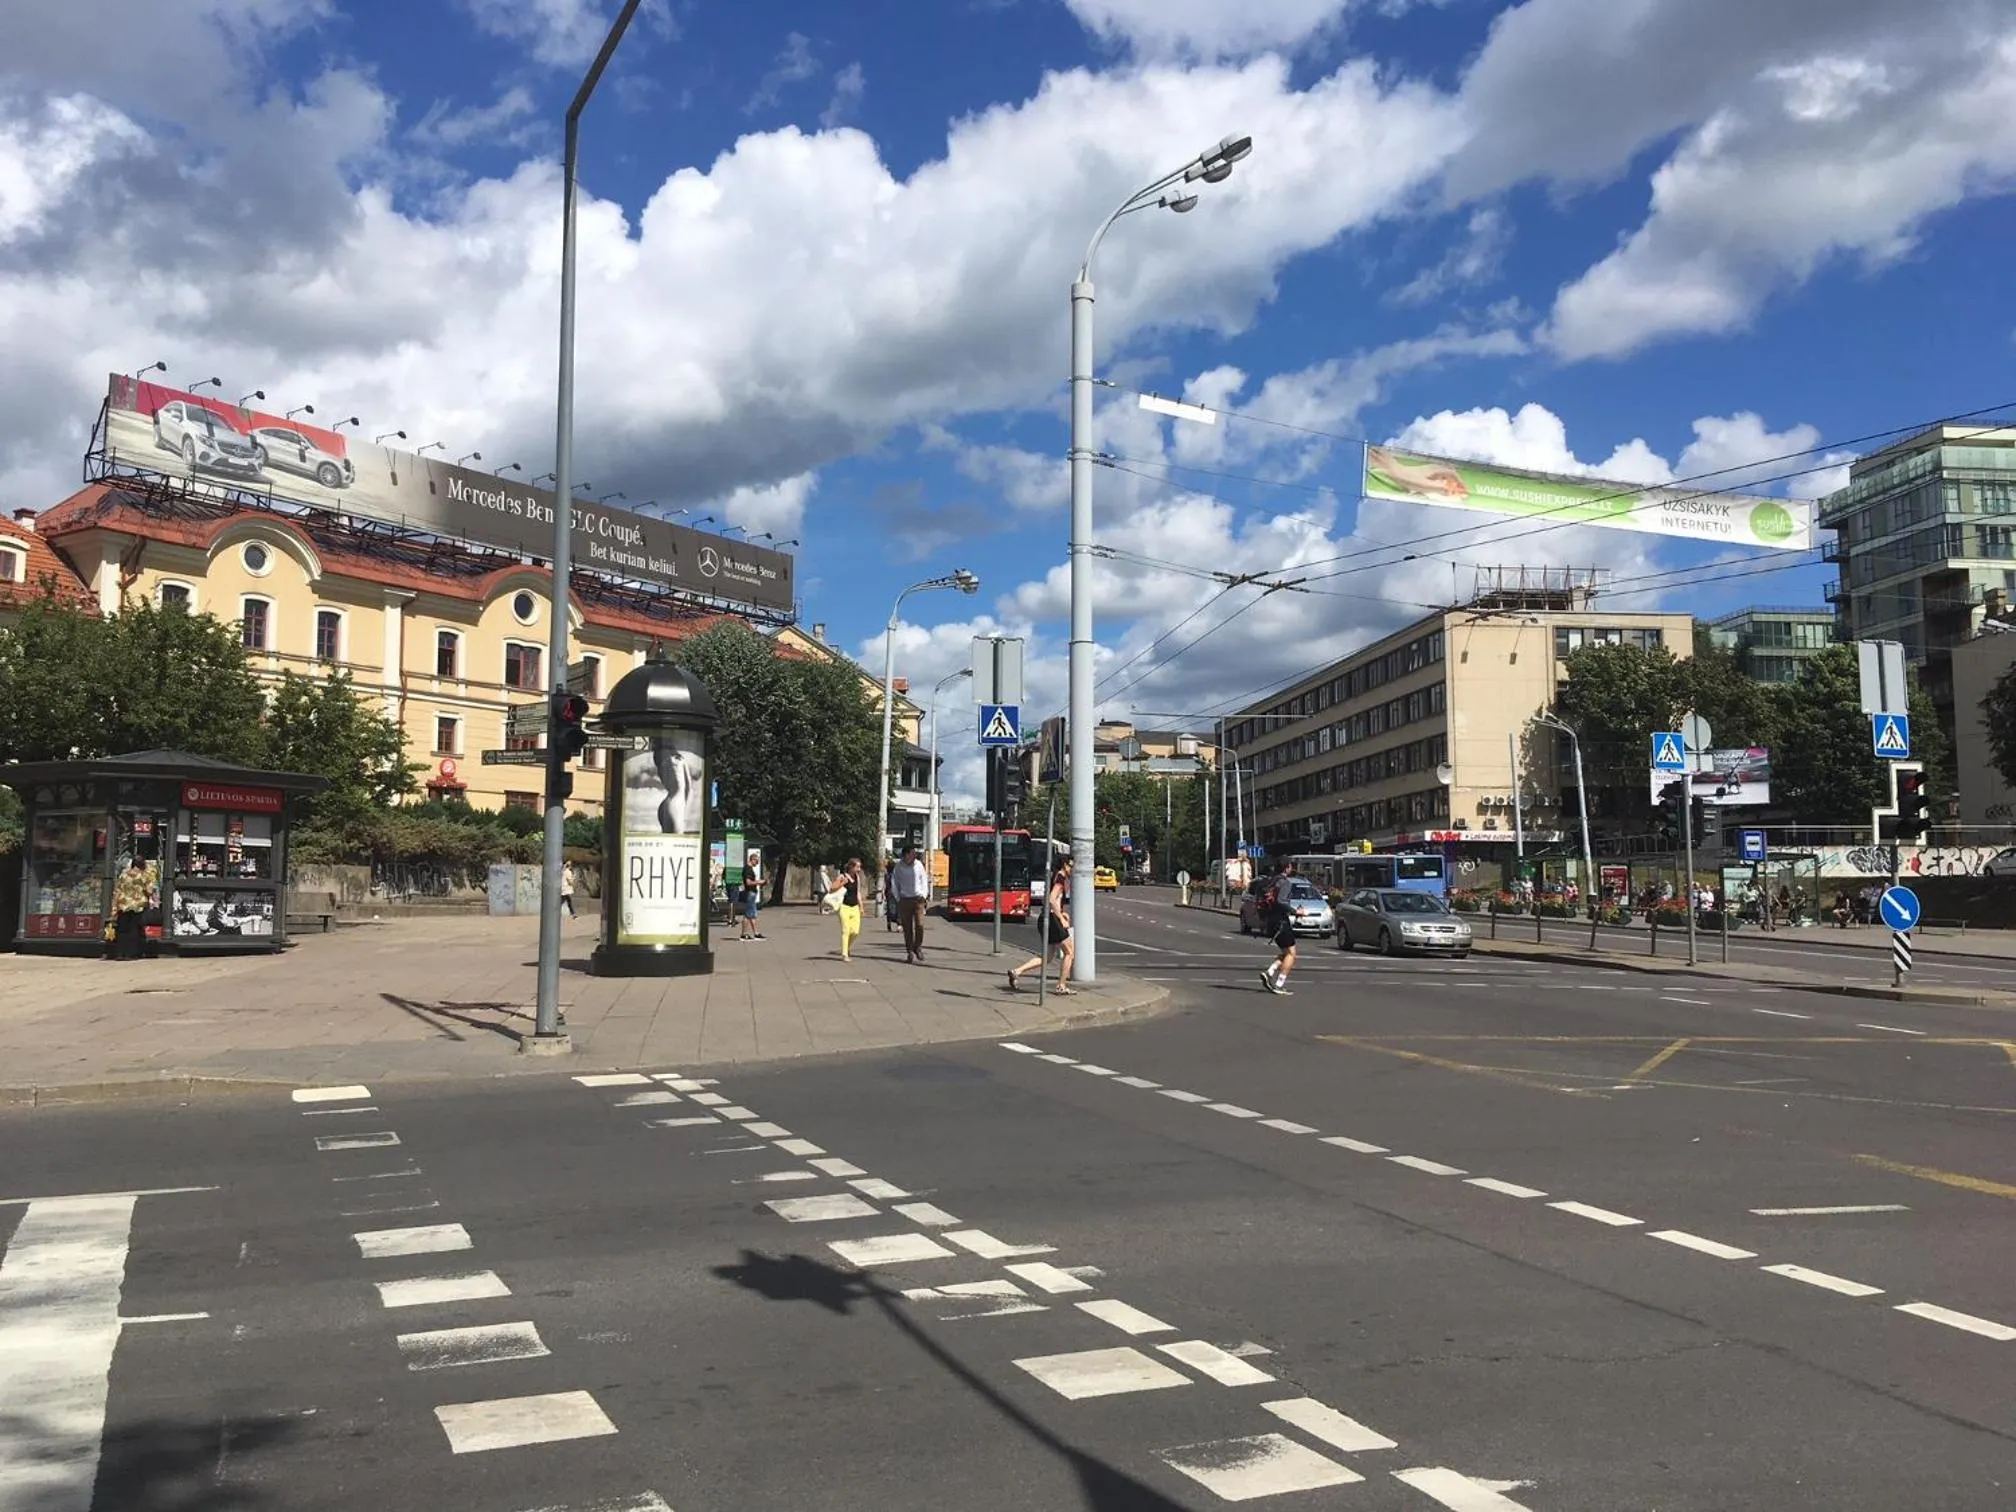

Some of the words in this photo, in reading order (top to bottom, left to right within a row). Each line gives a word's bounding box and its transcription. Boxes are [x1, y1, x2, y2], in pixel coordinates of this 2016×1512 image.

[448, 477, 522, 515] Mercedes
[526, 497, 554, 524] Ben
[1662, 497, 1731, 517] UŽSISAKYK
[1661, 516, 1732, 535] INTERNETU!
[590, 541, 607, 560] Bet
[609, 546, 646, 569] kuriam
[648, 555, 679, 577] keliui.
[629, 855, 695, 900] RHYE
